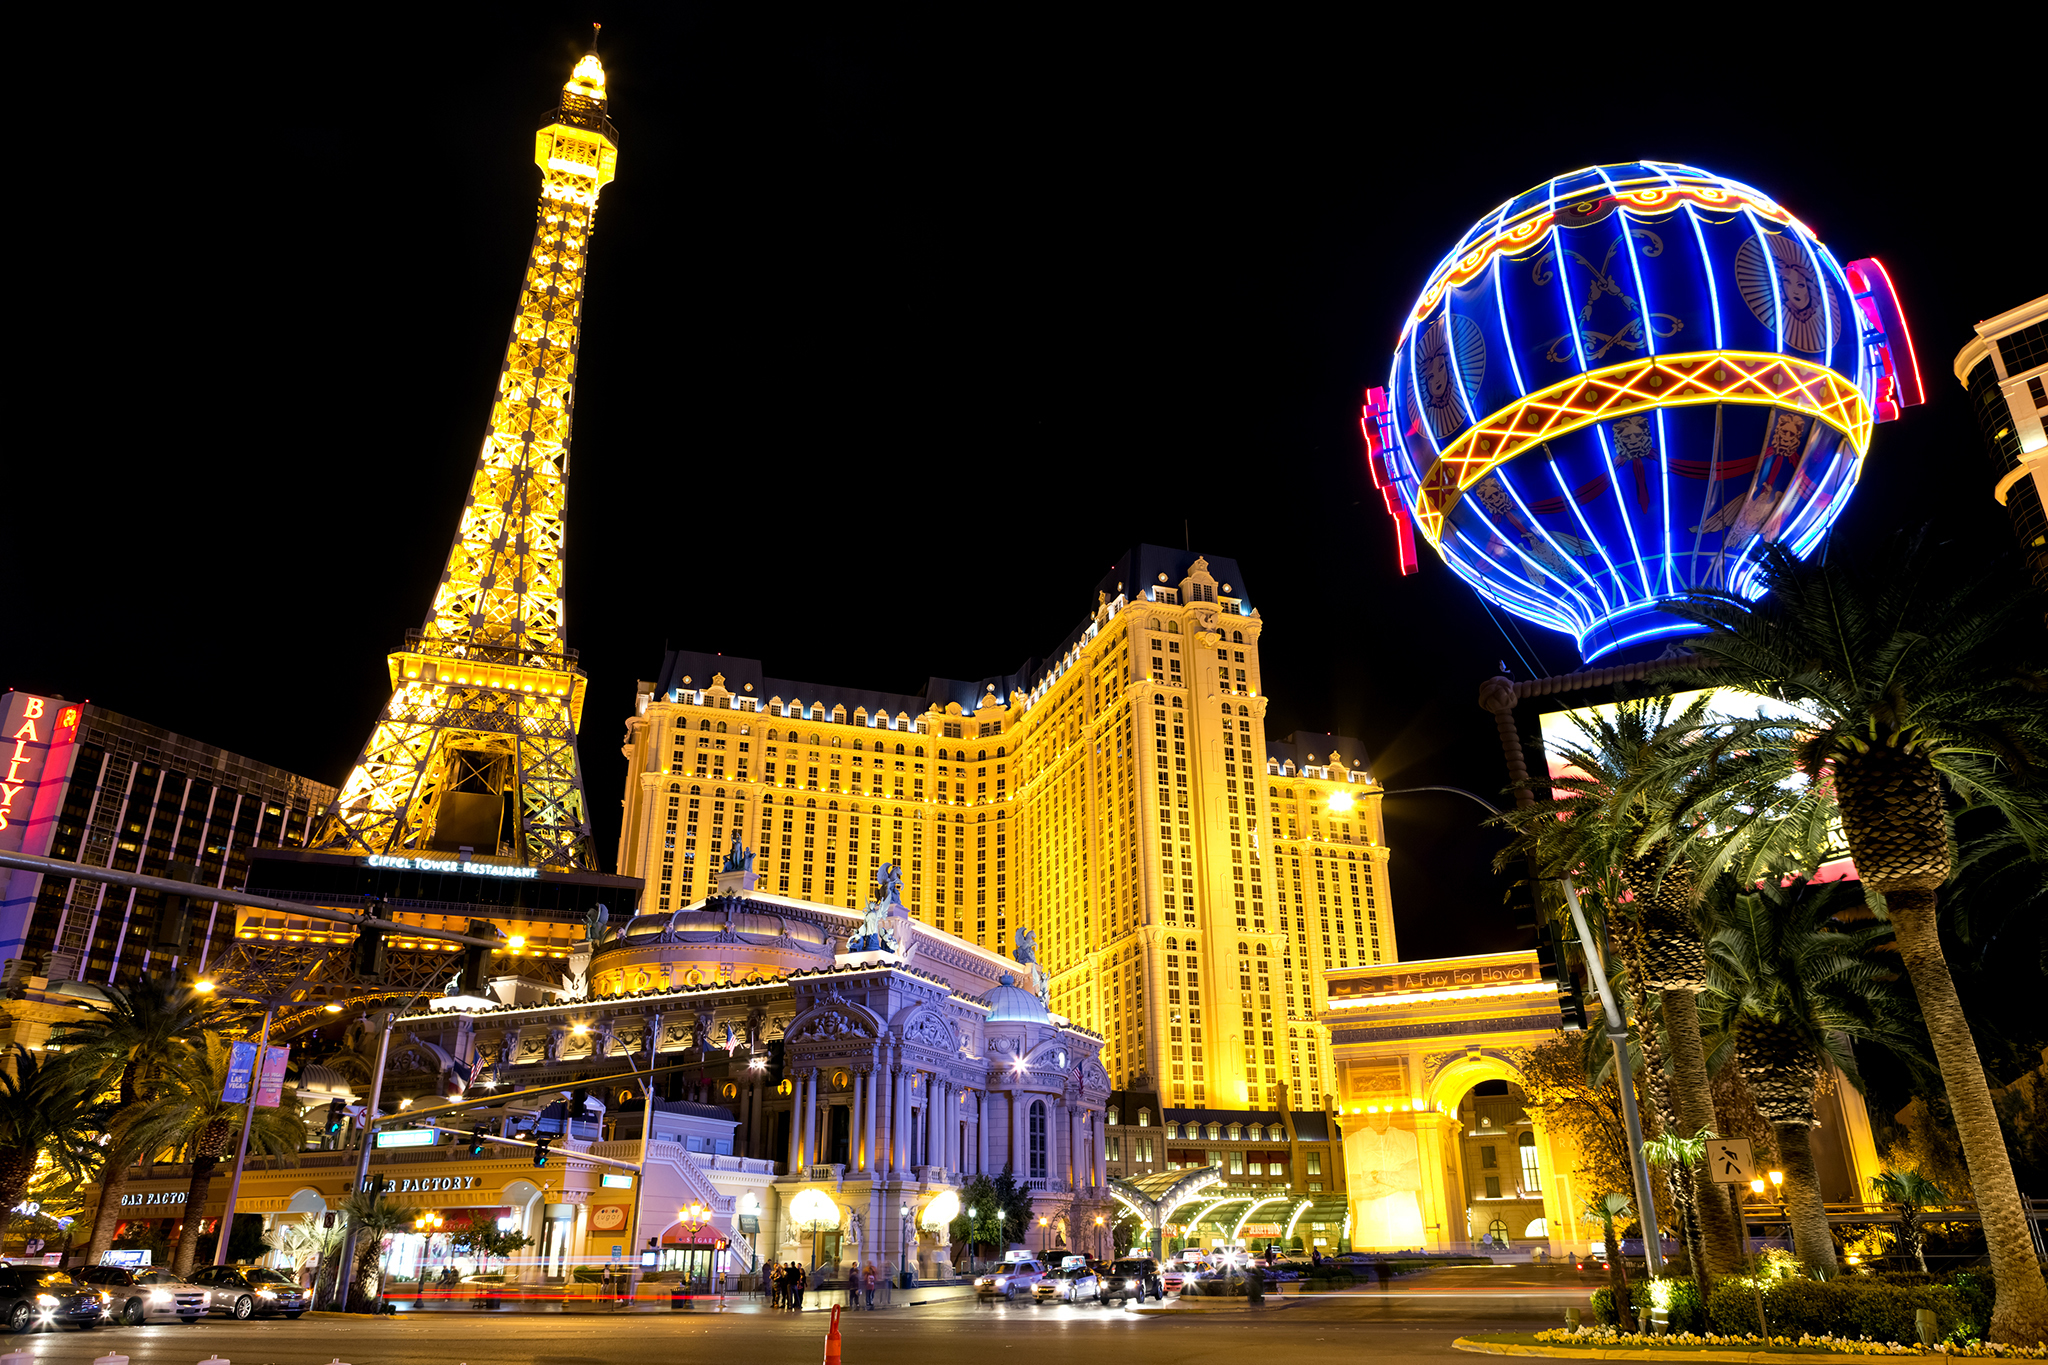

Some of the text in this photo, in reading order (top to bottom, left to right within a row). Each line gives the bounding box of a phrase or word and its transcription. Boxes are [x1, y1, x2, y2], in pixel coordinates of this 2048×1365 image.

[368, 854, 538, 879] EIFFEL TOWER RESTAURANT
[1404, 967, 1526, 988] A Fury For Flavor
[230, 1075, 243, 1083] LAS
[401, 1176, 474, 1193] FACTORY
